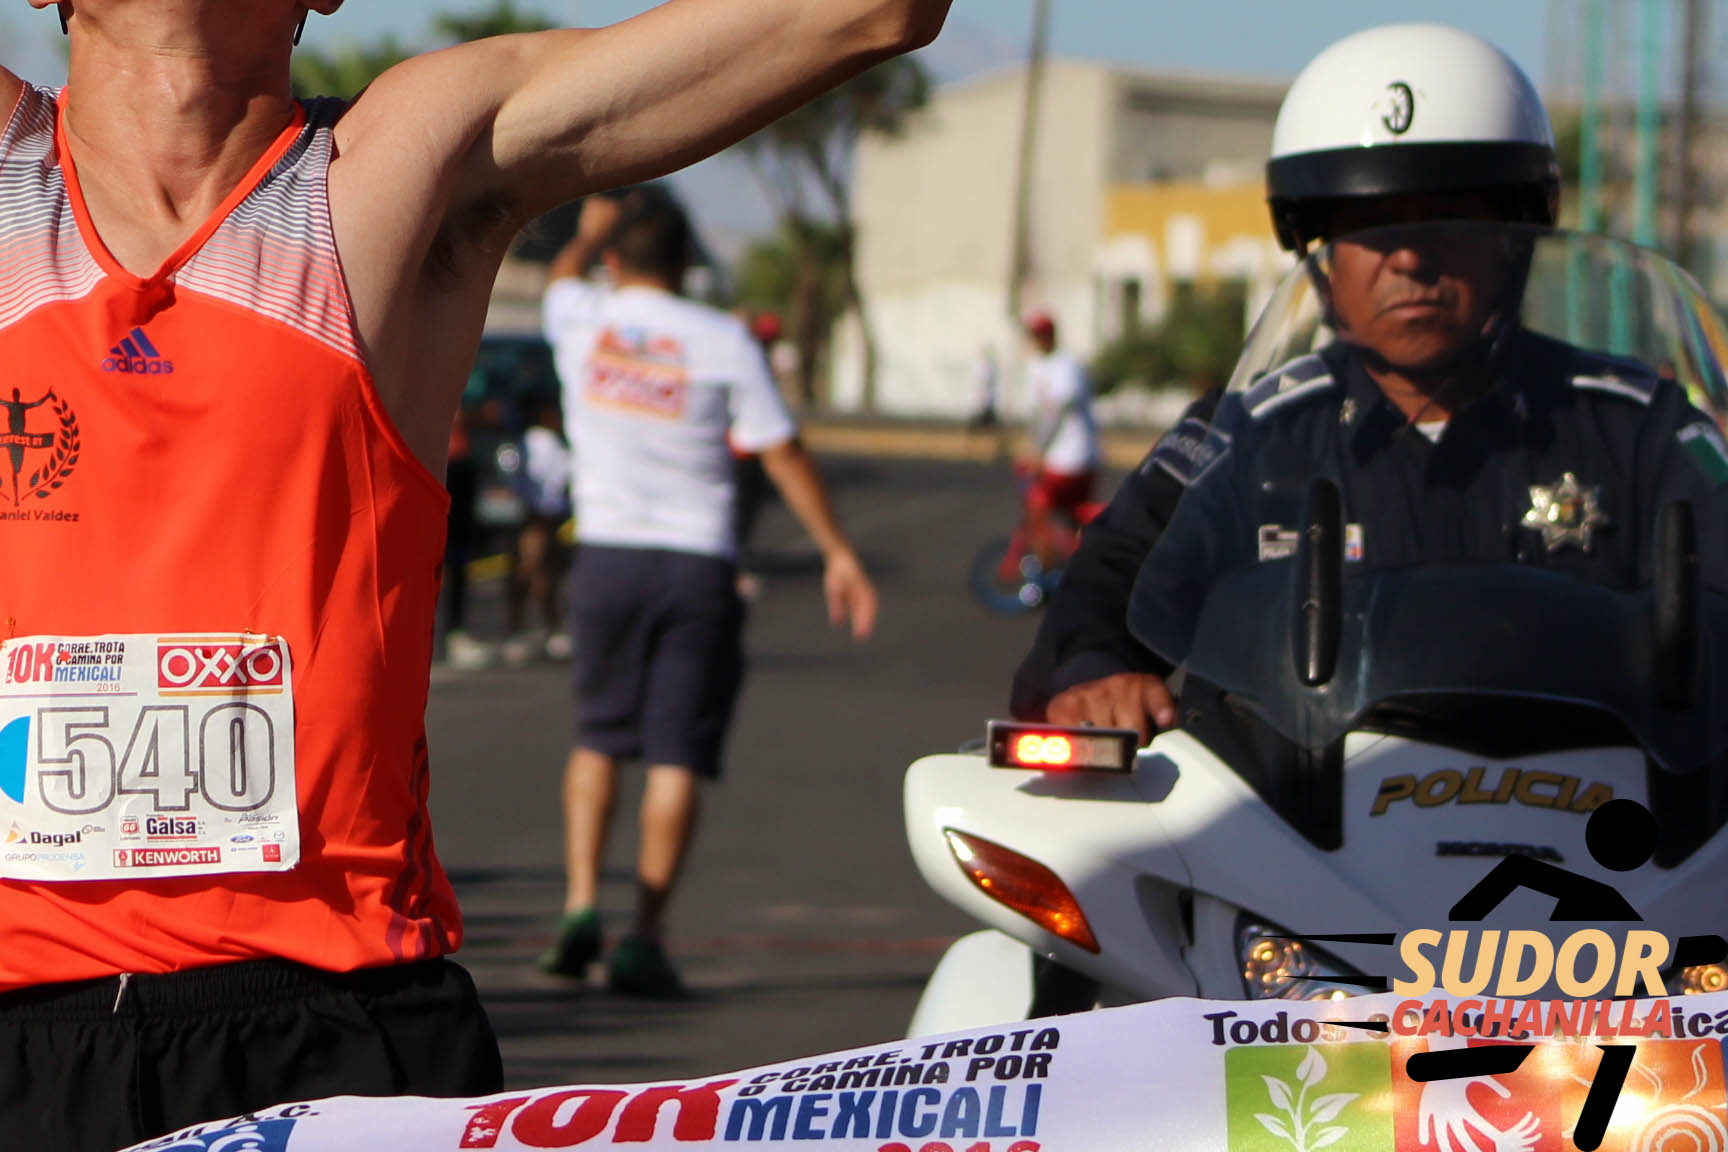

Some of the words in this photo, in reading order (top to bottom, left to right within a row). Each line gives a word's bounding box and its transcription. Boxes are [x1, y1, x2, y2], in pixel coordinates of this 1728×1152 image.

[102, 356, 174, 374] adidas
[33, 509, 80, 522] Valdez
[5, 643, 56, 683] 10K
[104, 653, 124, 665] POR
[160, 646, 282, 688] OXXO
[55, 665, 122, 682] MEXICALI
[96, 682, 121, 692] 2016
[37, 702, 276, 816] 540
[1369, 766, 1614, 817] POLICIA
[30, 830, 81, 847] Dagal
[146, 817, 196, 835] Galsa
[134, 849, 218, 864] KENWORTH
[920, 1027, 1061, 1061] TROTA
[781, 1061, 951, 1094] CAMINA
[965, 1051, 1053, 1083] POR
[458, 1078, 743, 1149] 10K
[723, 1083, 1043, 1142] MEXICALI
